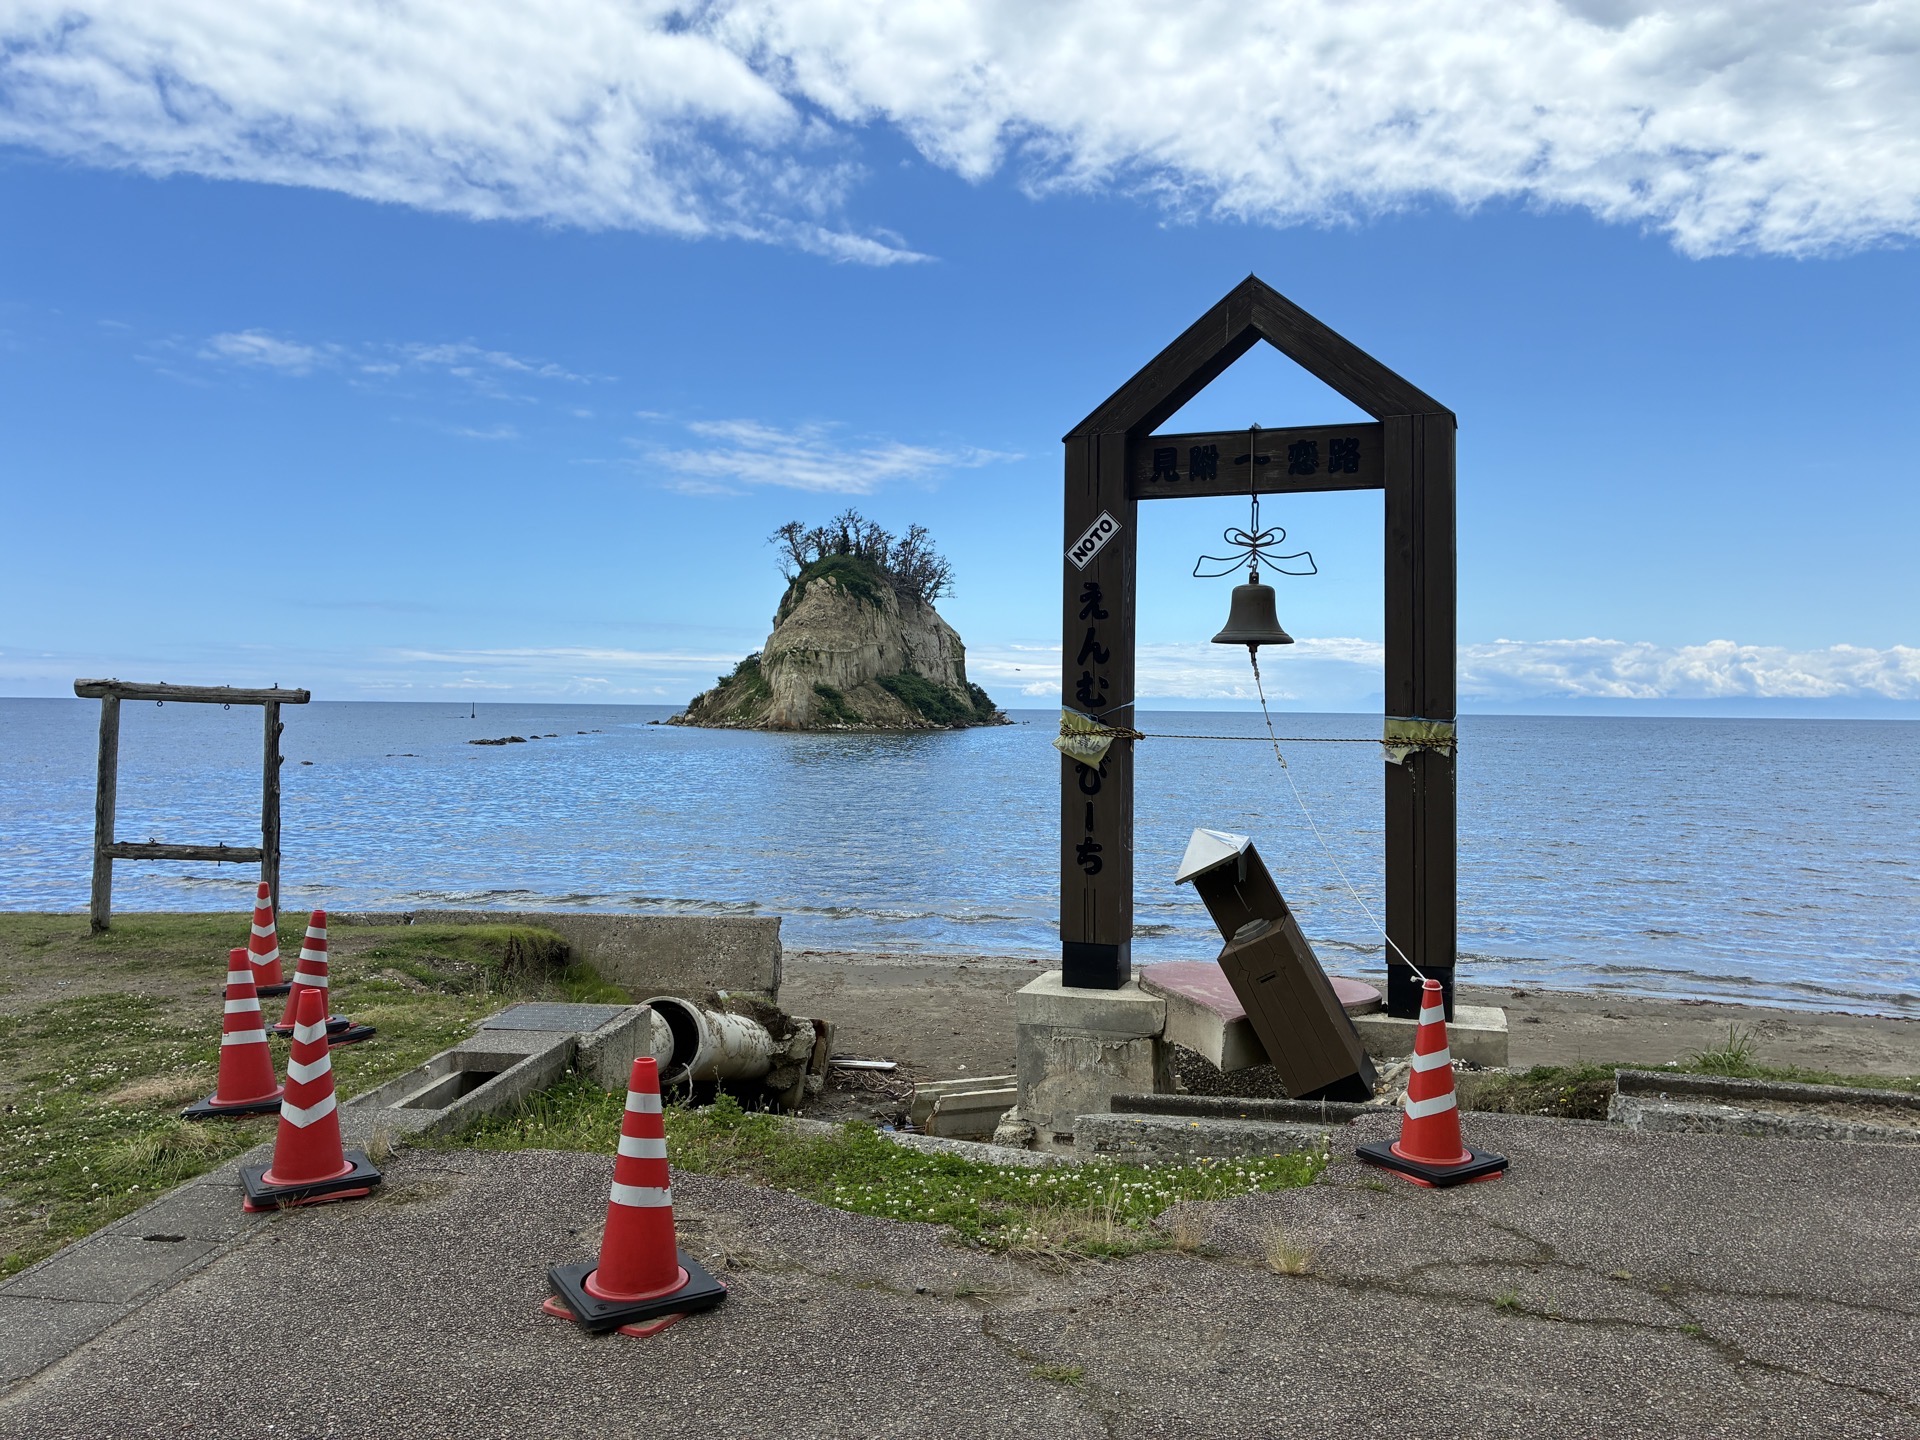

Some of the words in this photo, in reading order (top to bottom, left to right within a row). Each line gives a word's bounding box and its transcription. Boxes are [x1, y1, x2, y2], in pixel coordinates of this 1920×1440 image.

[1072, 519, 1113, 563] NOTO
[1075, 582, 1112, 875] えんむびーち
